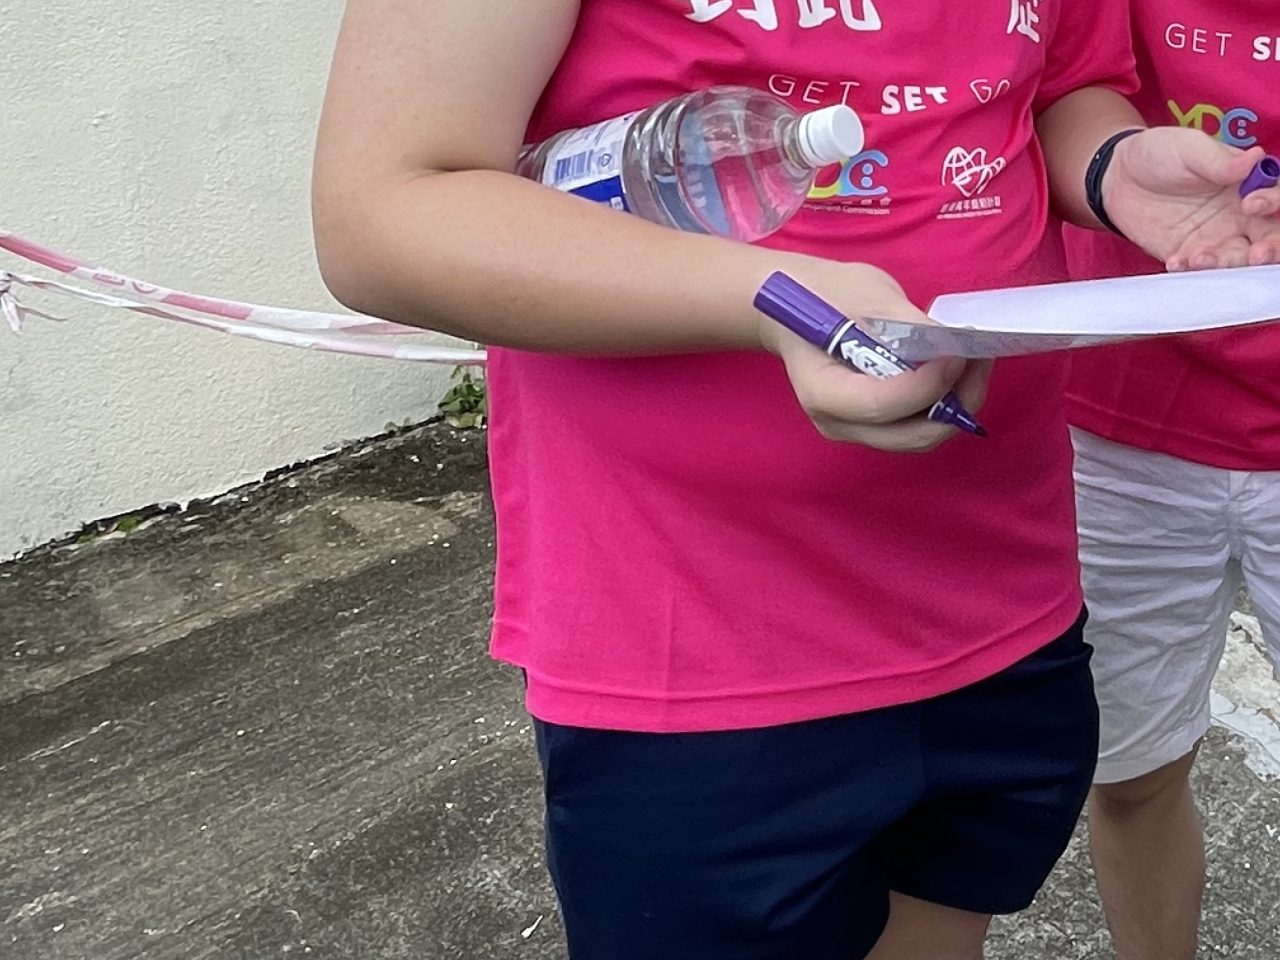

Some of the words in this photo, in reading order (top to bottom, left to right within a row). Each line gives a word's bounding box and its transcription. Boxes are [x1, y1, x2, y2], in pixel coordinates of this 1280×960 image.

[1165, 22, 1232, 57] GET
[768, 73, 860, 106] GET
[880, 84, 949, 116] SET
